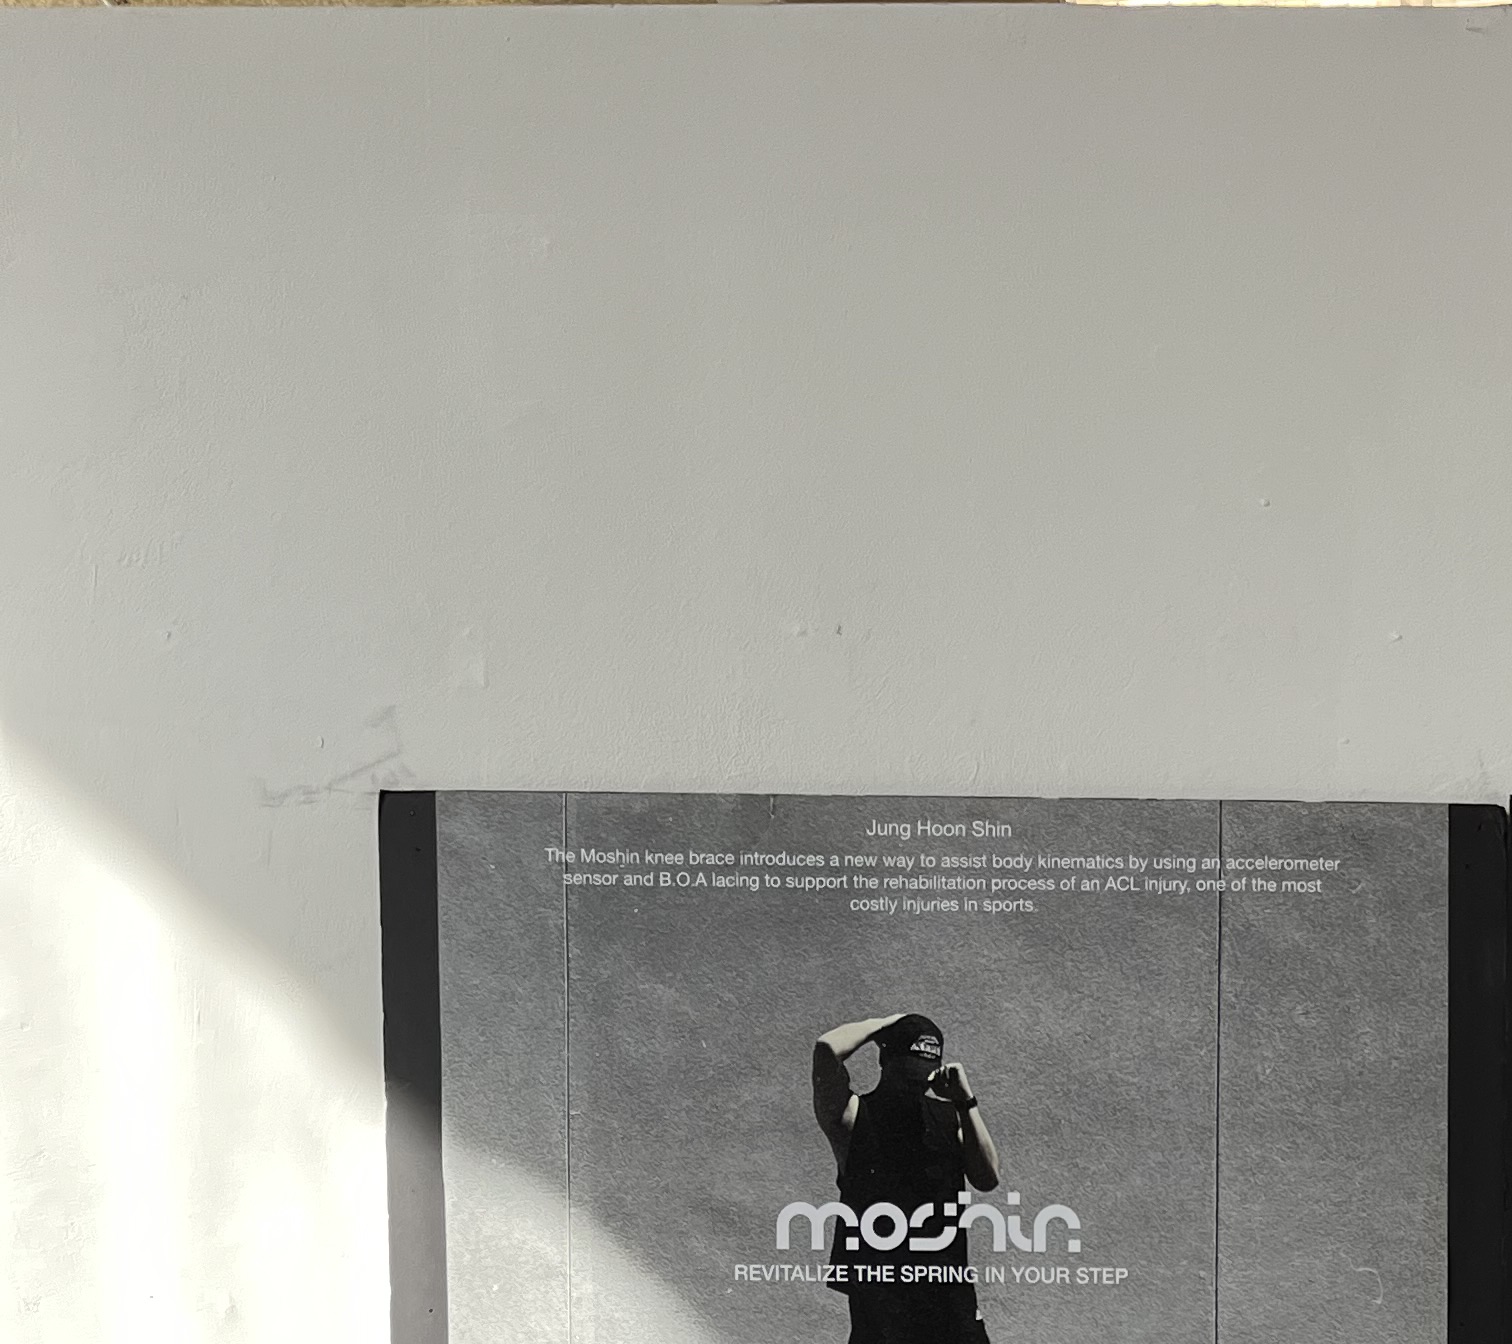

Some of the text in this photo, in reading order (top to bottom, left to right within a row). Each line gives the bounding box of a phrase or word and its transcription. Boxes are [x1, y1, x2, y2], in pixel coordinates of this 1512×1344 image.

[865, 819, 1011, 840] Jung Hoon Shin
[544, 848, 1340, 873] The Moshin knee brace introduces a new way to assist body kinematics by using an accelerometer
[562, 871, 1322, 894] sensor and B.O.A lacing to support the rehabilitation process of an ACL injury, one of the most
[849, 895, 1038, 915] costly injuries in sports.
[776, 1191, 1081, 1253] moshin
[734, 1264, 1127, 1284] REVITALIZE THE SPRING IN YOUR STEP
